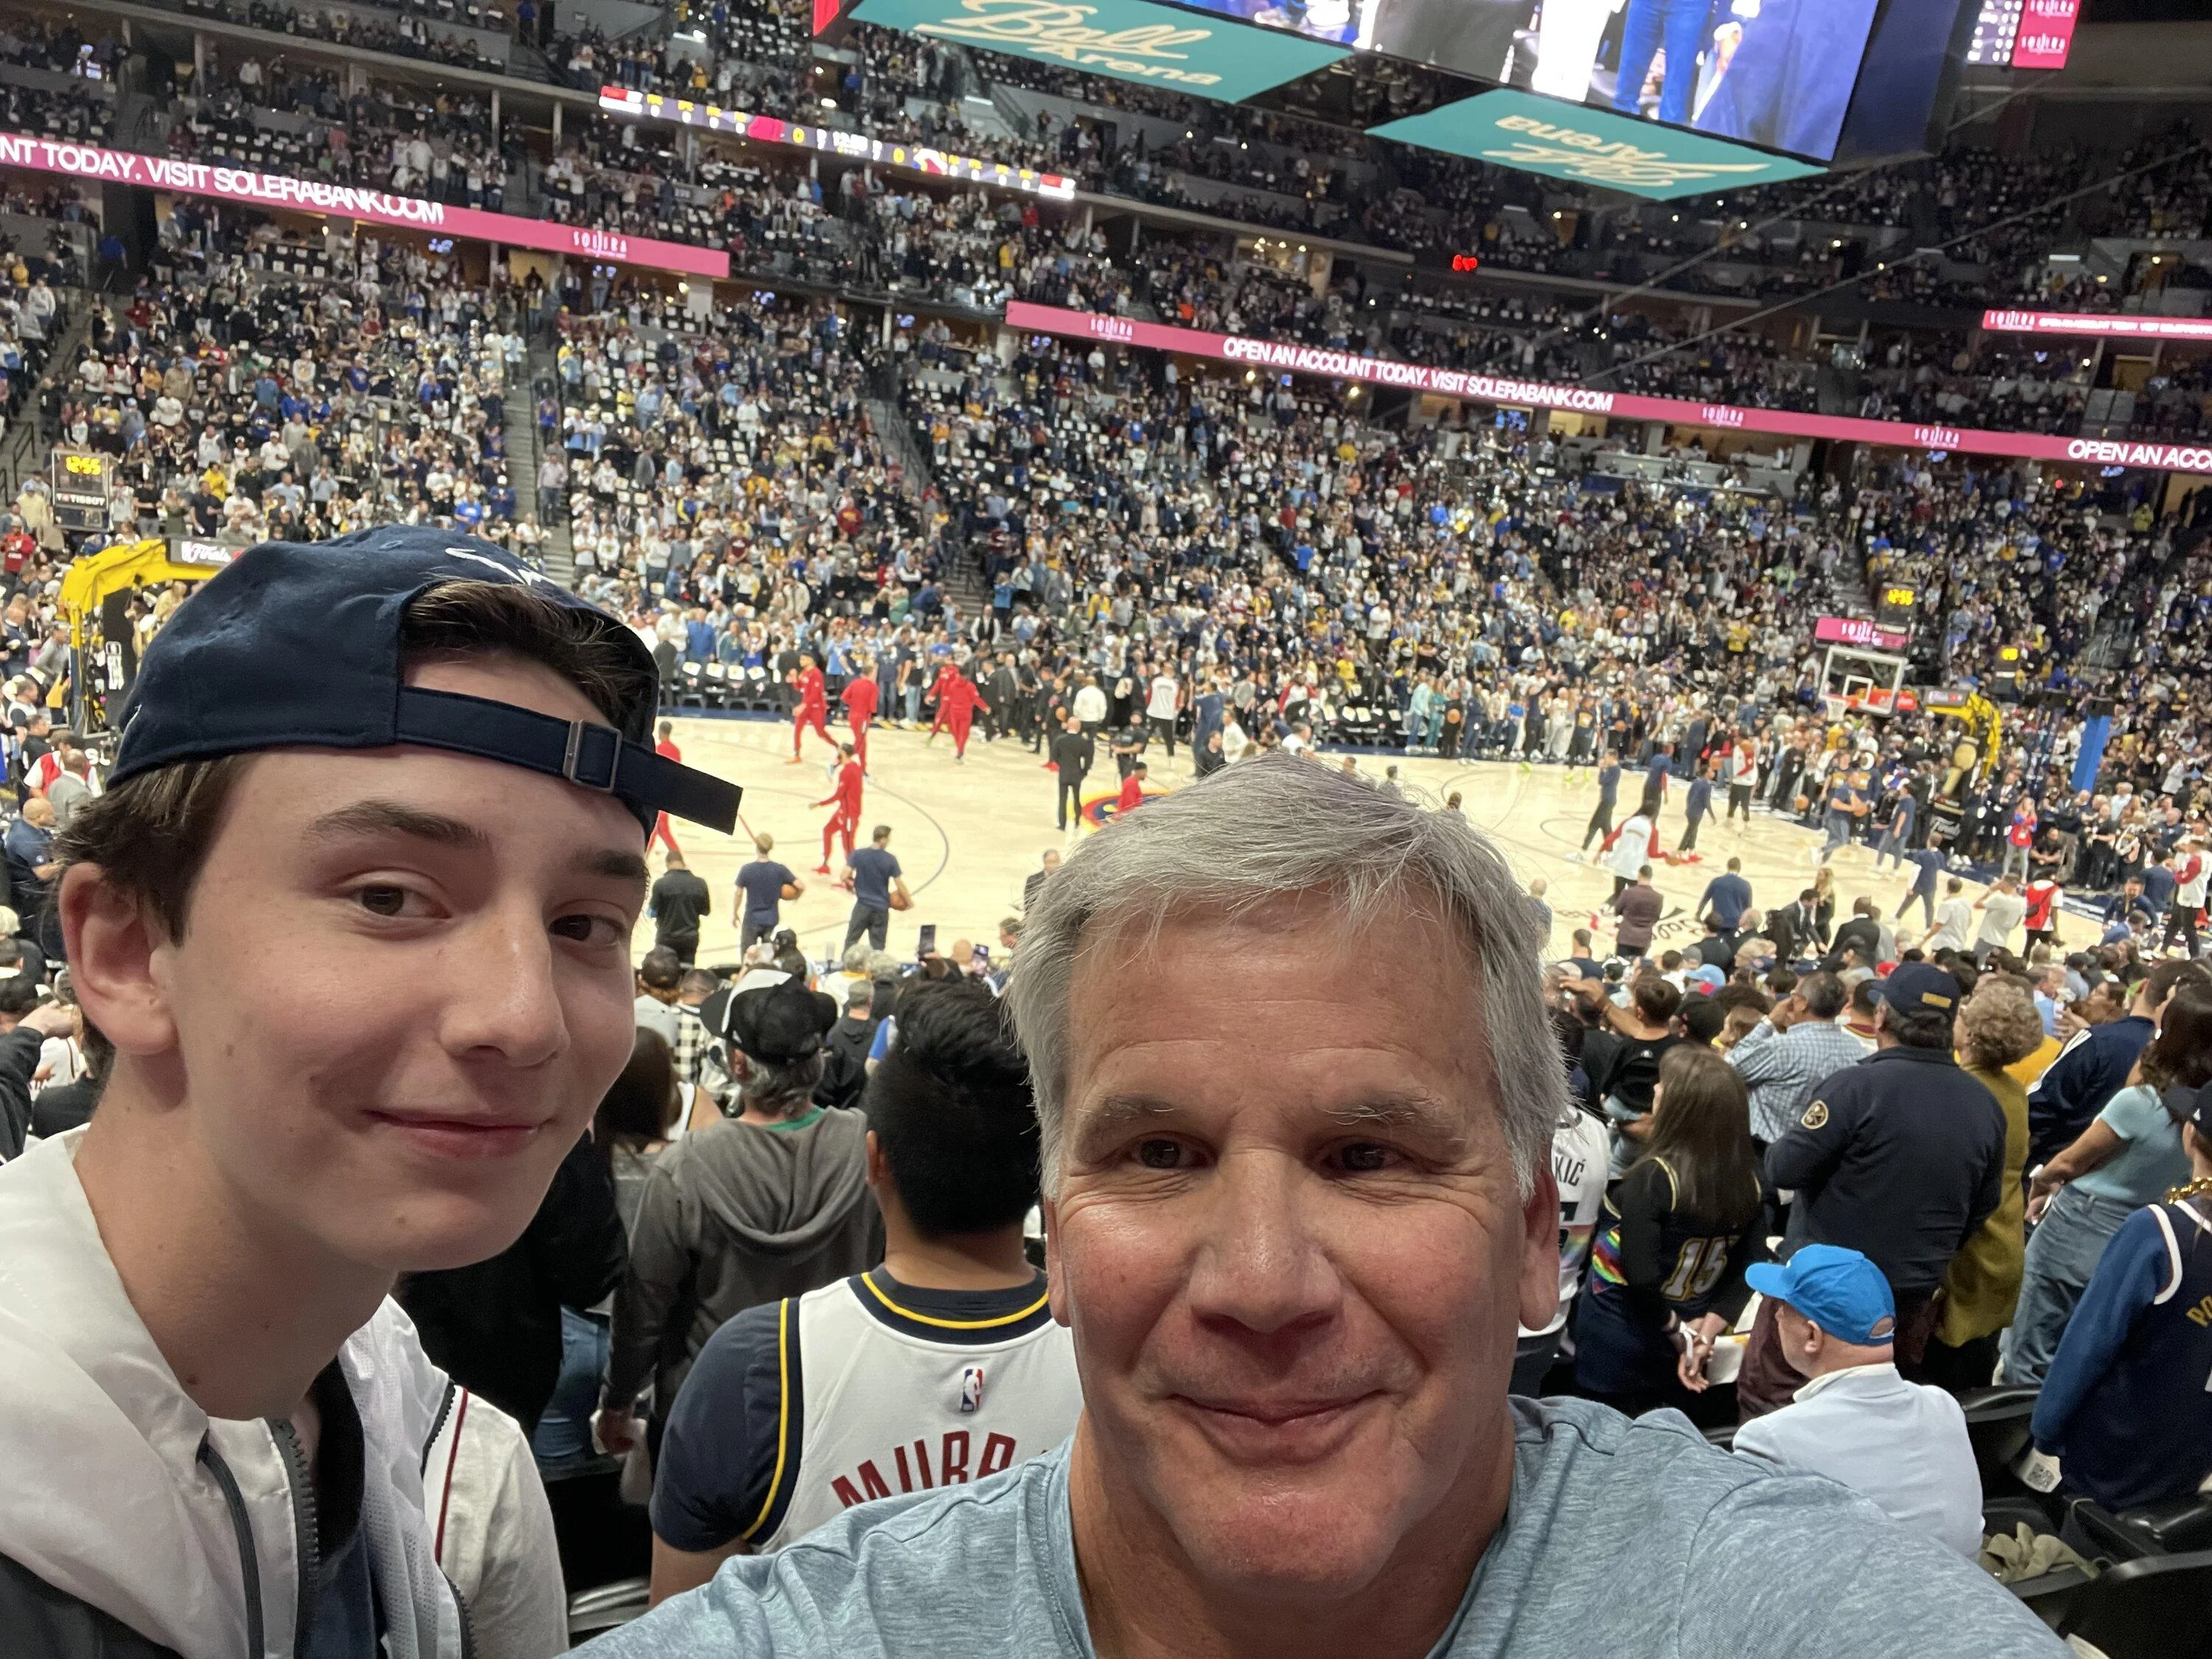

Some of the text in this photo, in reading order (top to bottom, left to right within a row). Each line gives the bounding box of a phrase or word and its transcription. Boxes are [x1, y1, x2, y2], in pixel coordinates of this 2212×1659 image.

[914, 0, 1213, 59] Ball
[1027, 45, 1222, 86] Arena
[41, 142, 142, 181] TODAY.
[145, 156, 210, 189] VISIT
[1223, 336, 1614, 412] OPEN AN ACCOUNT TODAY. VISIT SOLERABANK.COM
[2067, 439, 2212, 470] OPEN AN ACC
[1554, 1157, 1587, 1187] KIĆ
[1660, 1237, 1737, 1301] 15
[831, 1430, 1047, 1509] MURR
